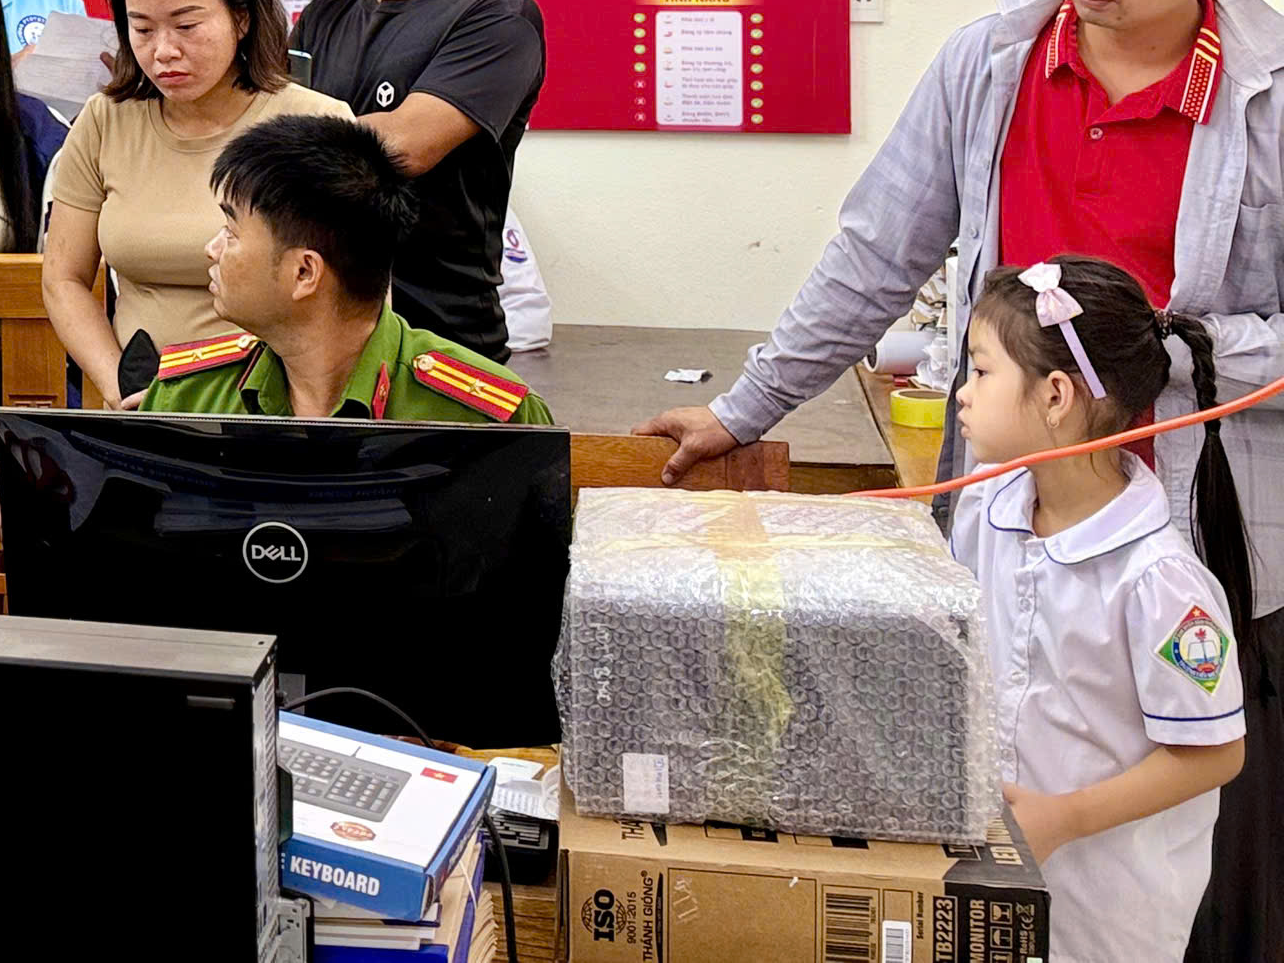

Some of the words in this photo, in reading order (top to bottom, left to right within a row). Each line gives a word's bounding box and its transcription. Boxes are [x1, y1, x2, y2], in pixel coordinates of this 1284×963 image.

[251, 544, 302, 562] DELL
[290, 854, 381, 897] KEYBOARD
[989, 846, 1023, 865] LED
[593, 888, 615, 943] ISO
[626, 891, 637, 944] 9001:2015
[916, 891, 924, 918] Number
[640, 920, 653, 962] THÁNH
[916, 919, 924, 940] Serial
[969, 899, 985, 963] MONITOR
